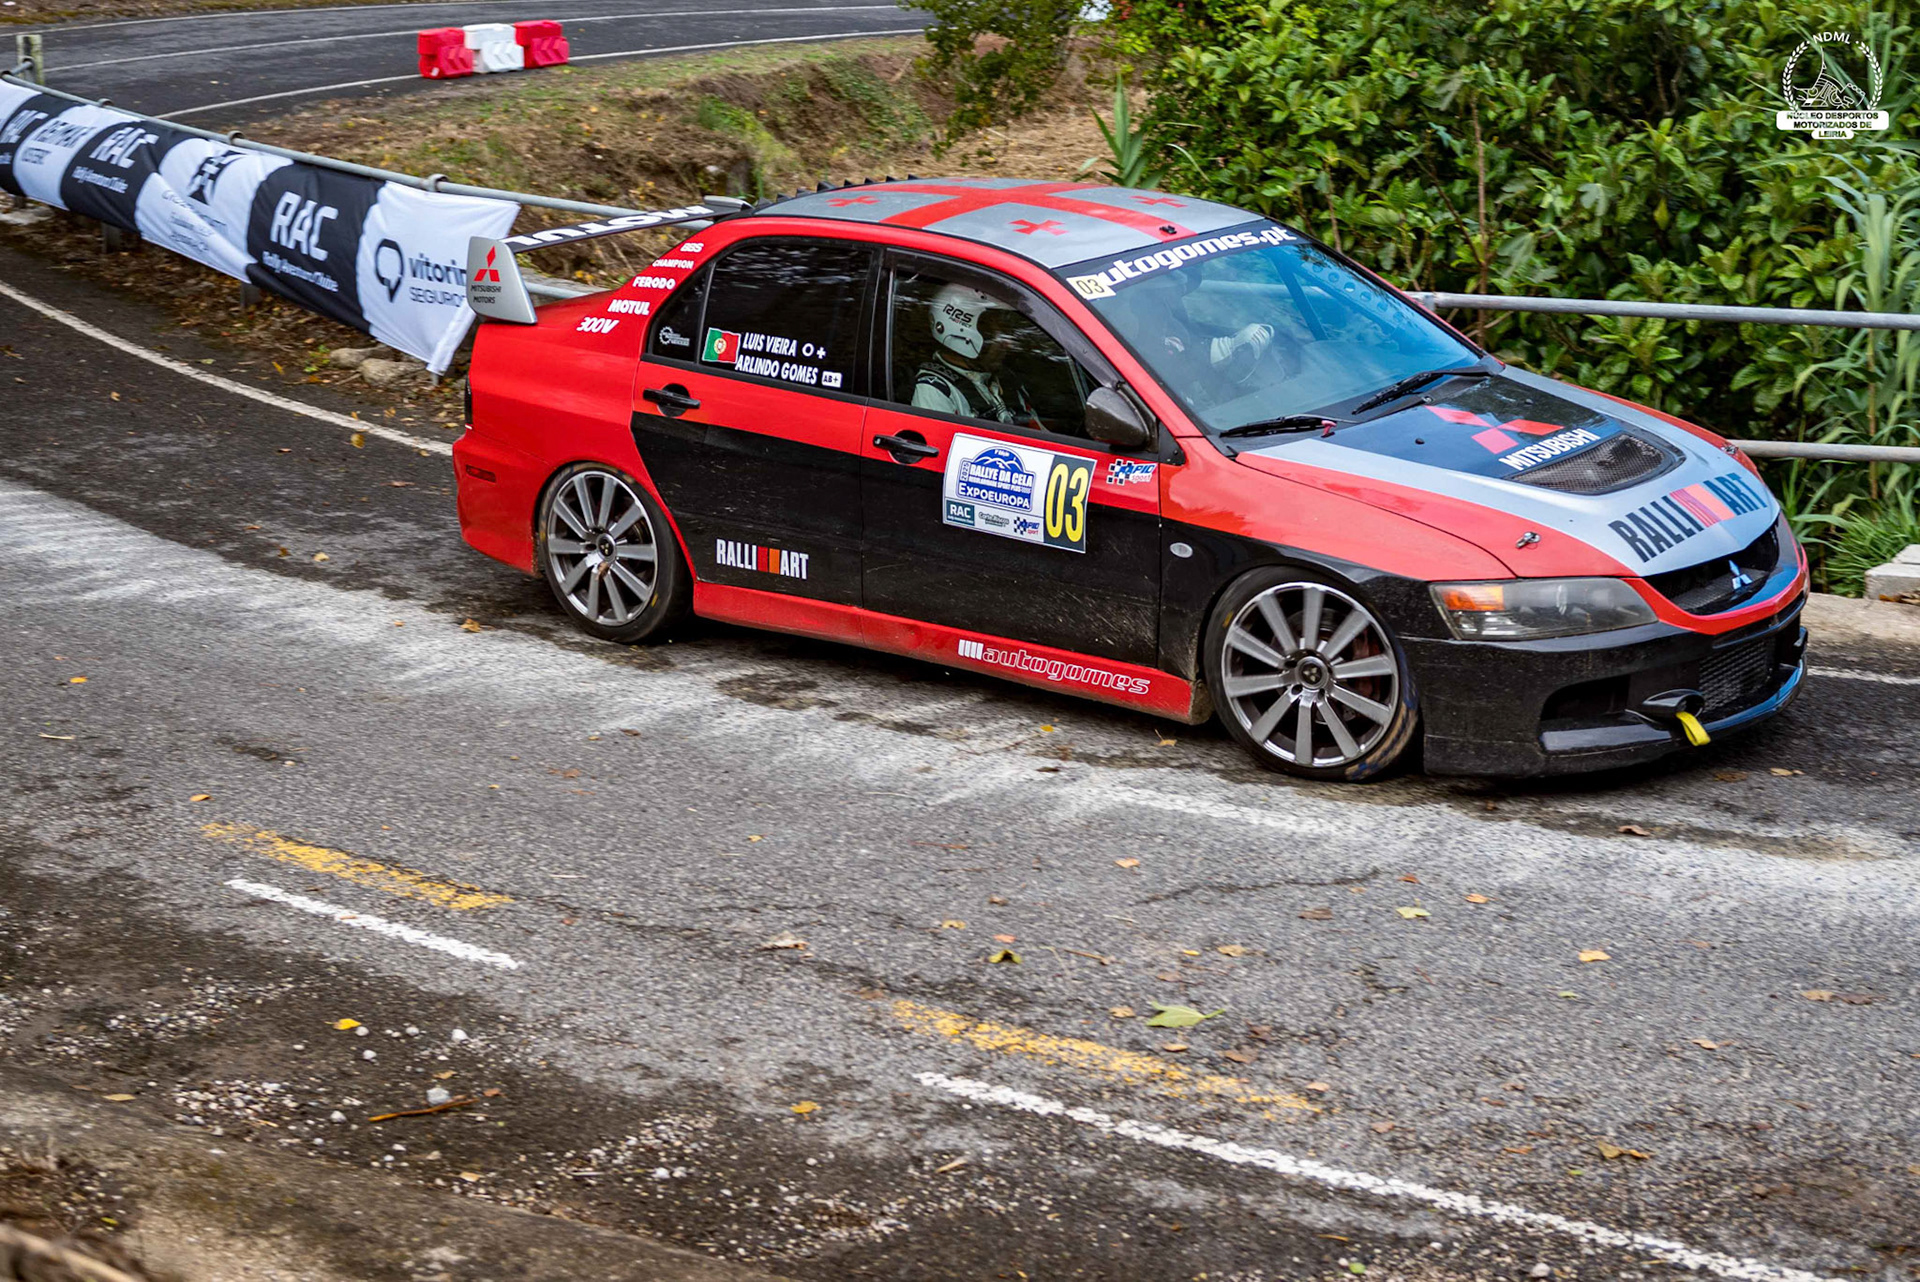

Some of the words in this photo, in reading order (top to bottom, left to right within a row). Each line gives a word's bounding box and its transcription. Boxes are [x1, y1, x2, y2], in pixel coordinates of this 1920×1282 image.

[89, 126, 160, 169] RAC
[270, 191, 339, 261] RAC
[680, 242, 704, 253] BBS
[1097, 226, 1297, 287] utogomes.pt
[408, 252, 467, 286] vitorin
[652, 259, 694, 270] CHAMPION
[470, 284, 502, 293] MITSUBISHI
[633, 276, 676, 290] FERODO
[1076, 279, 1105, 295] 03
[473, 295, 496, 304] MOTORS
[607, 299, 650, 315] MOTUL
[942, 303, 974, 323] RRS
[576, 317, 619, 333] 300V
[742, 332, 764, 352] LUIS
[765, 336, 798, 358] VIEIRA
[735, 355, 780, 378] ARLINDO
[781, 362, 819, 385] GOMES
[1498, 428, 1602, 472] MITSUBISHI
[970, 464, 999, 481] RALLYE
[998, 470, 1011, 483] DA
[1011, 472, 1033, 488] CELA
[949, 504, 971, 518] RAC
[1045, 463, 1089, 543] 03
[982, 647, 1150, 695] autogomes
